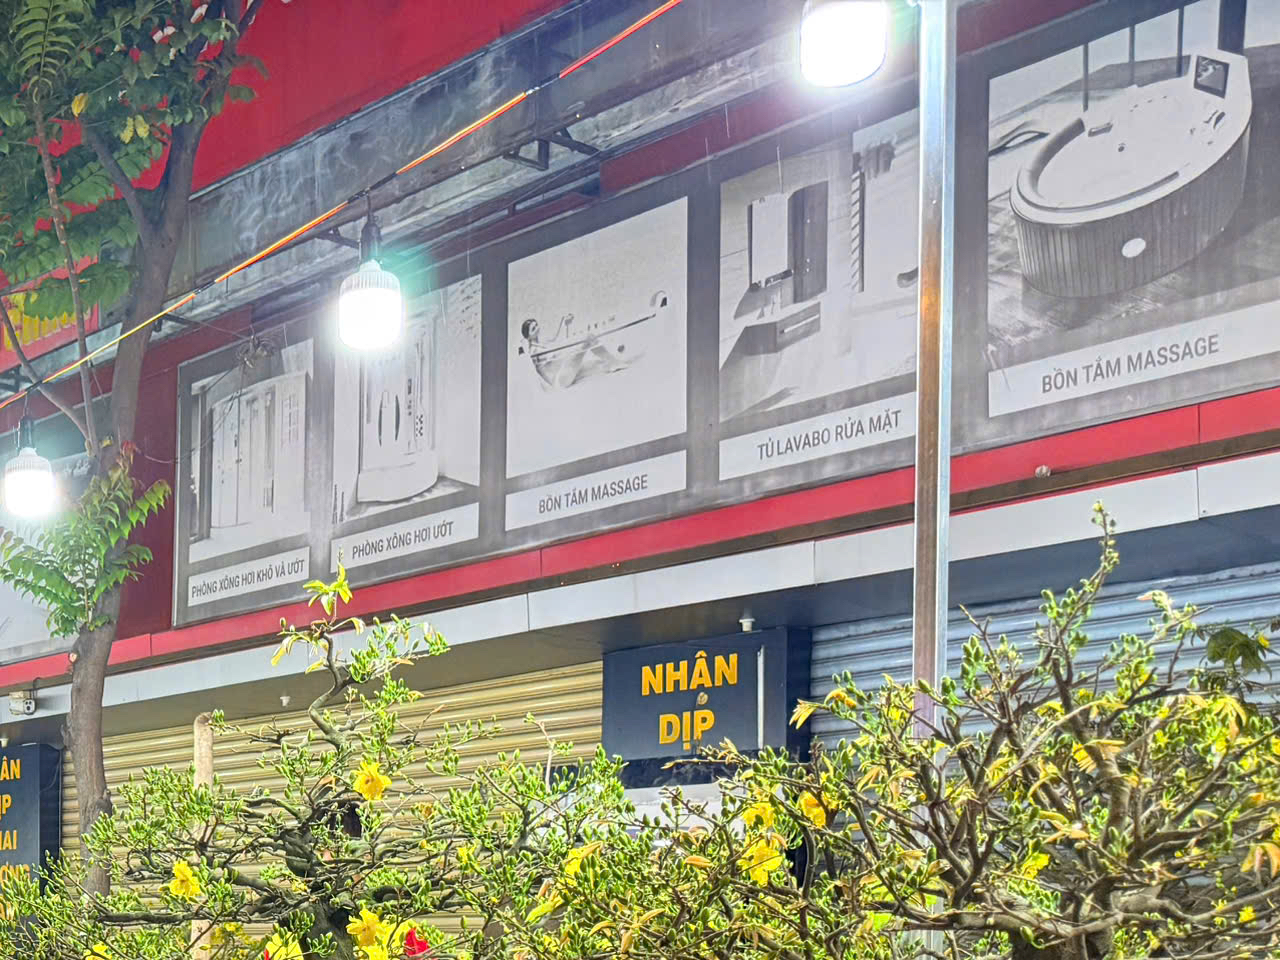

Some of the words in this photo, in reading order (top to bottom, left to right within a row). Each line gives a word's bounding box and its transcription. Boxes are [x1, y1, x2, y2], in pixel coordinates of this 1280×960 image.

[1042, 368, 1078, 394] BỒN
[1082, 356, 1121, 384] TẮM
[1127, 334, 1220, 374] MASSAGE
[757, 437, 775, 461] TỦ
[776, 427, 831, 456] LAVABO
[835, 416, 866, 443] RỬA
[869, 408, 902, 435] MẶT
[591, 474, 649, 502] MASSAGE
[352, 540, 384, 560] PHÒNG
[191, 580, 218, 599] PHÒNG
[641, 650, 739, 697] NHÂN
[659, 709, 716, 751] DỊP
